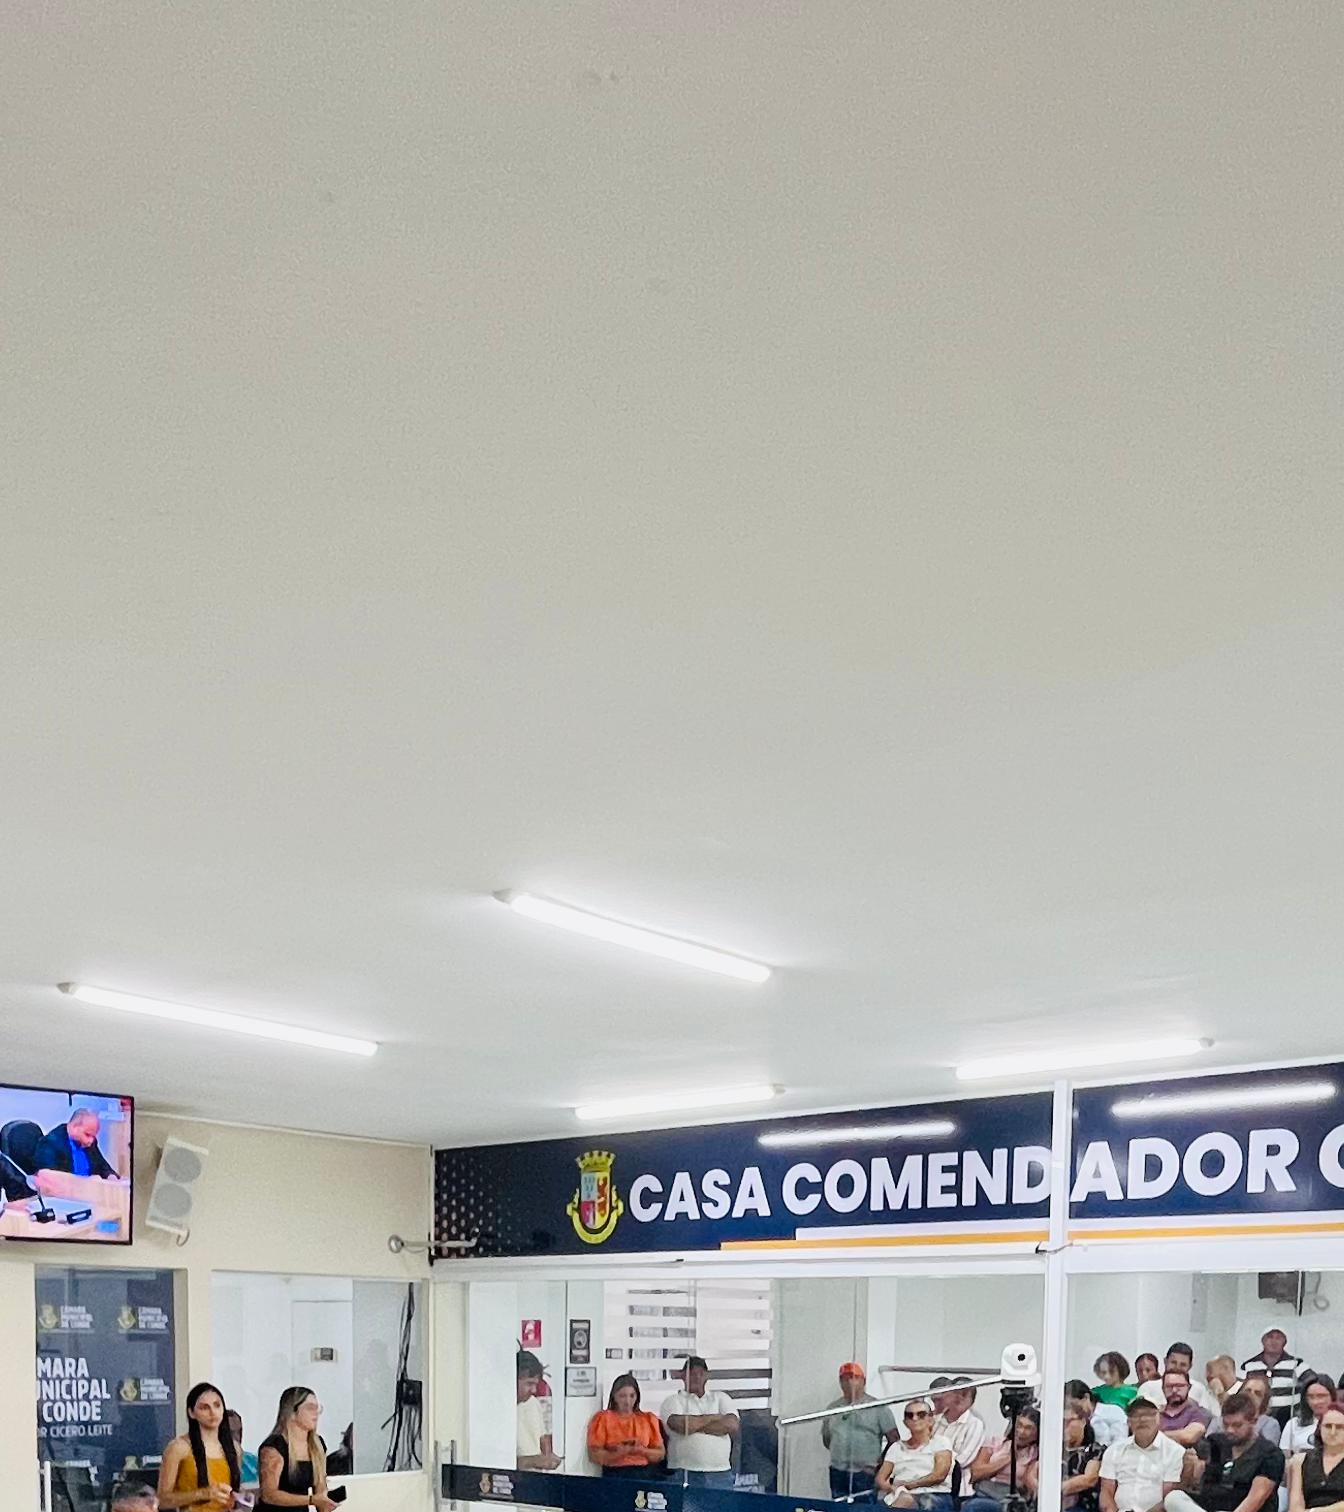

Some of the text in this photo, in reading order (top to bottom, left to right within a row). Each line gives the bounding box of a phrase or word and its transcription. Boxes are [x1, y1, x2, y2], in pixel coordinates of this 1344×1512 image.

[629, 1166, 772, 1223] CASA
[782, 1128, 1300, 1216] COMENDADOR
[37, 1357, 90, 1379] MARA
[37, 1379, 111, 1401] NICIPAL
[42, 1401, 102, 1423] CONDE
[87, 1423, 113, 1437] LEITE
